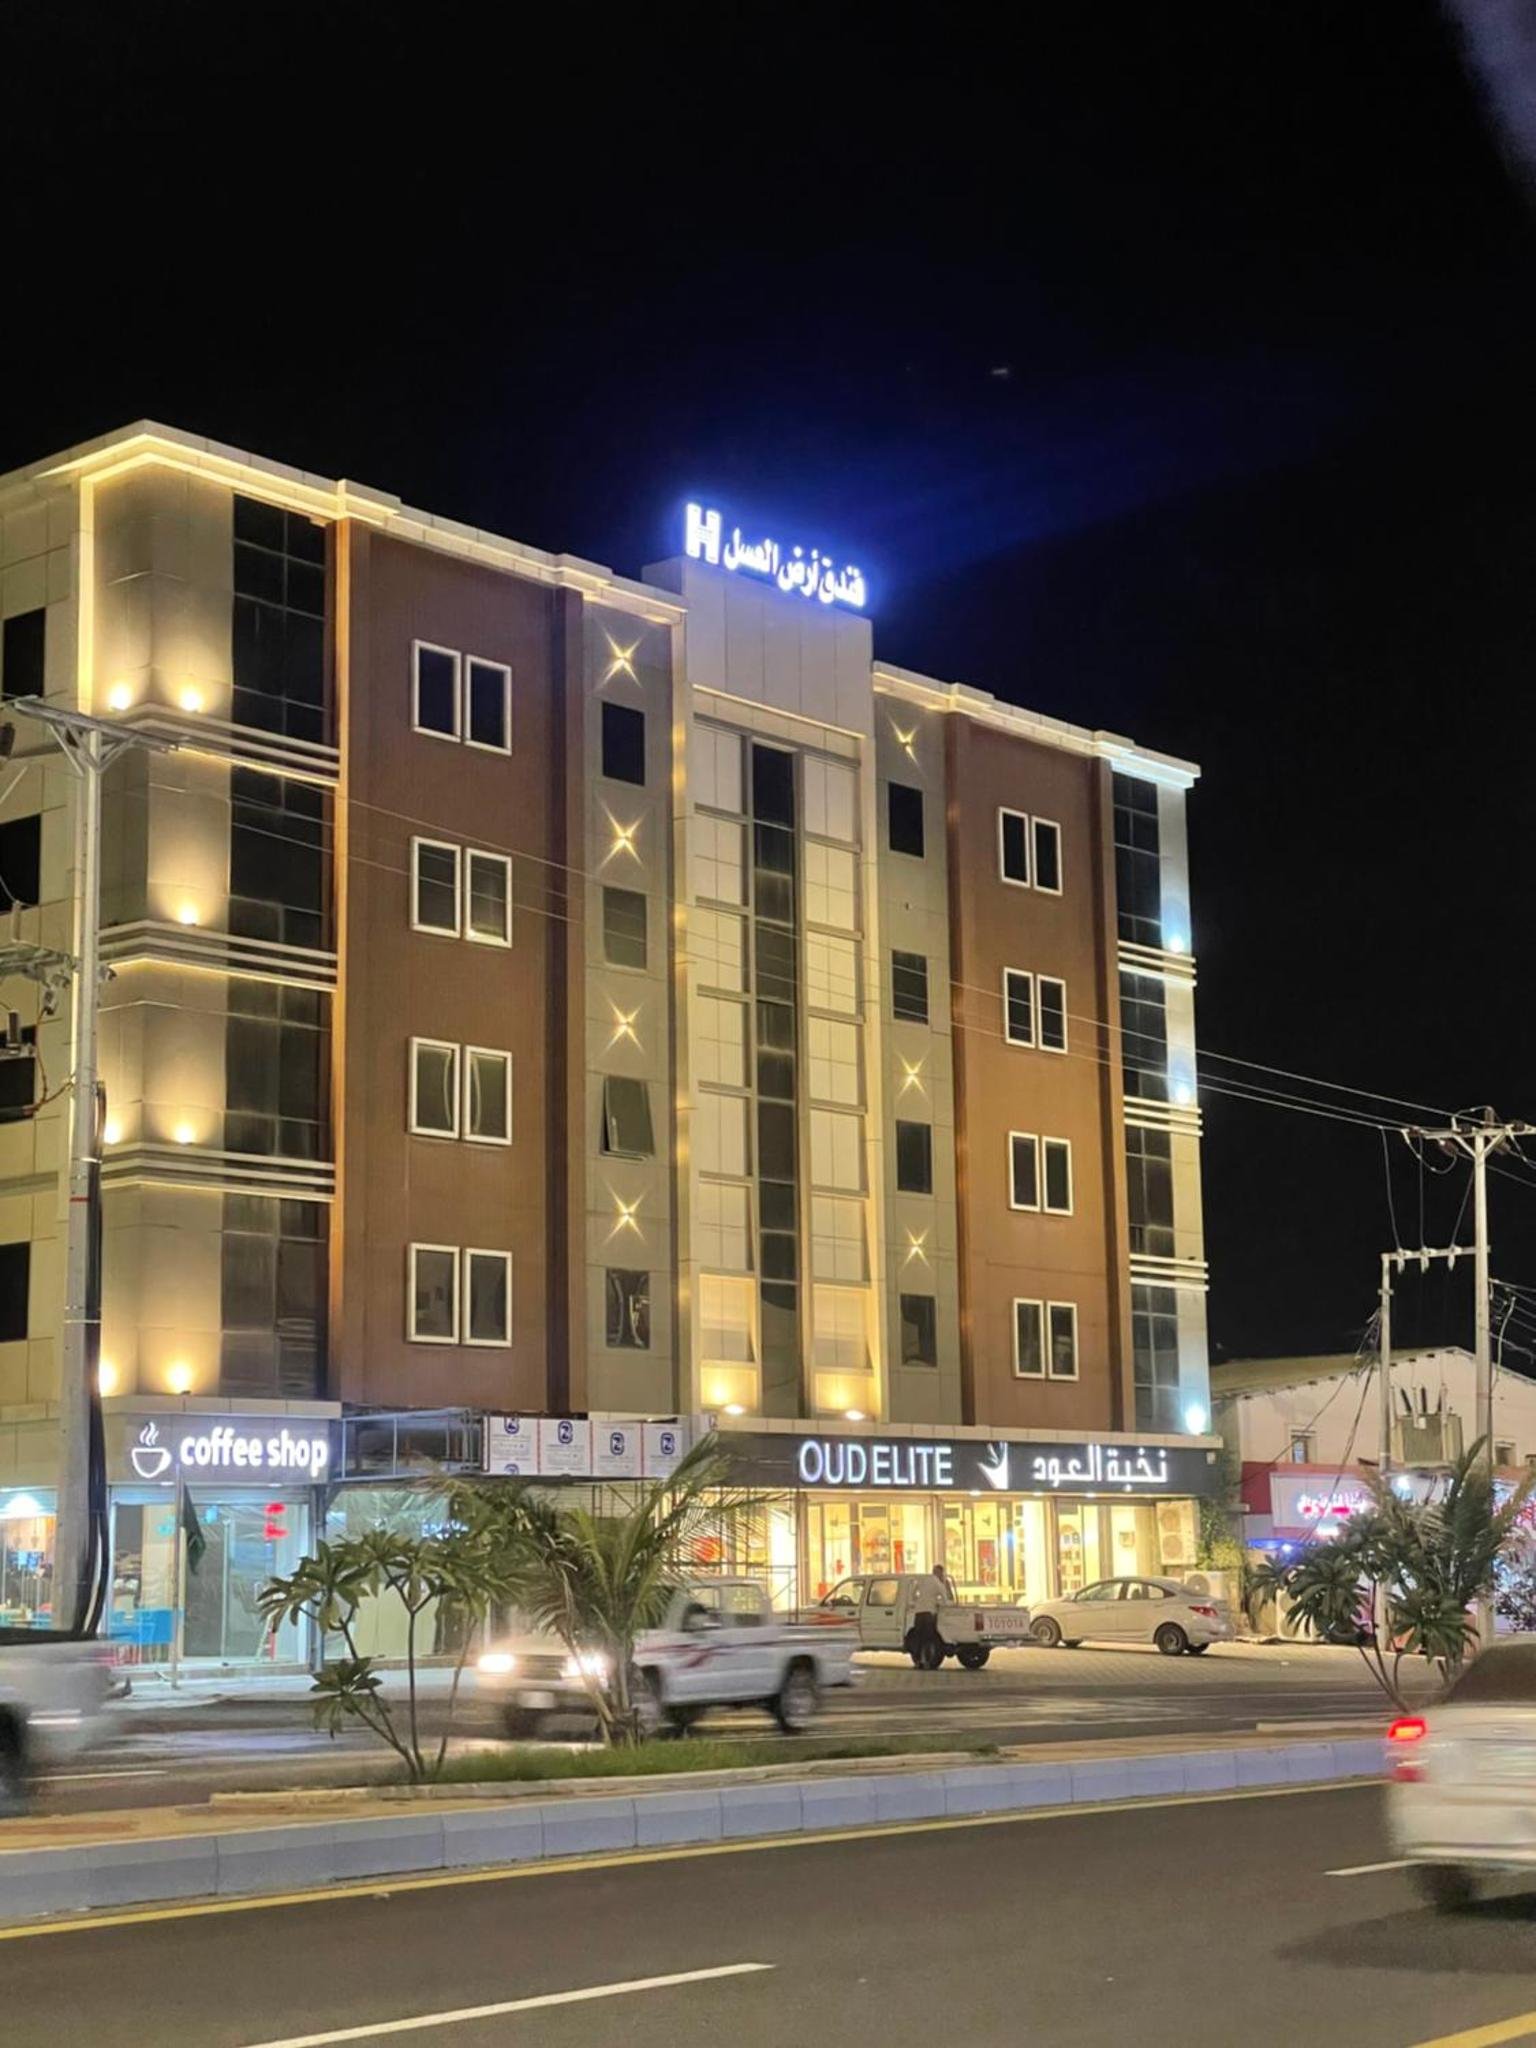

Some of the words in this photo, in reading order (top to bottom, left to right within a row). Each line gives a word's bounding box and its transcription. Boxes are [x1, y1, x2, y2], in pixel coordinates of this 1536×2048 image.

[686, 503, 721, 565] H
[818, 557, 866, 608] فندق
[180, 1427, 262, 1466] coffee
[267, 1429, 328, 1477] shop
[800, 1440, 867, 1484] OUD
[873, 1445, 954, 1485] ELITE
[1033, 1444, 1102, 1488] العود
[1106, 1447, 1167, 1492] نخبة
